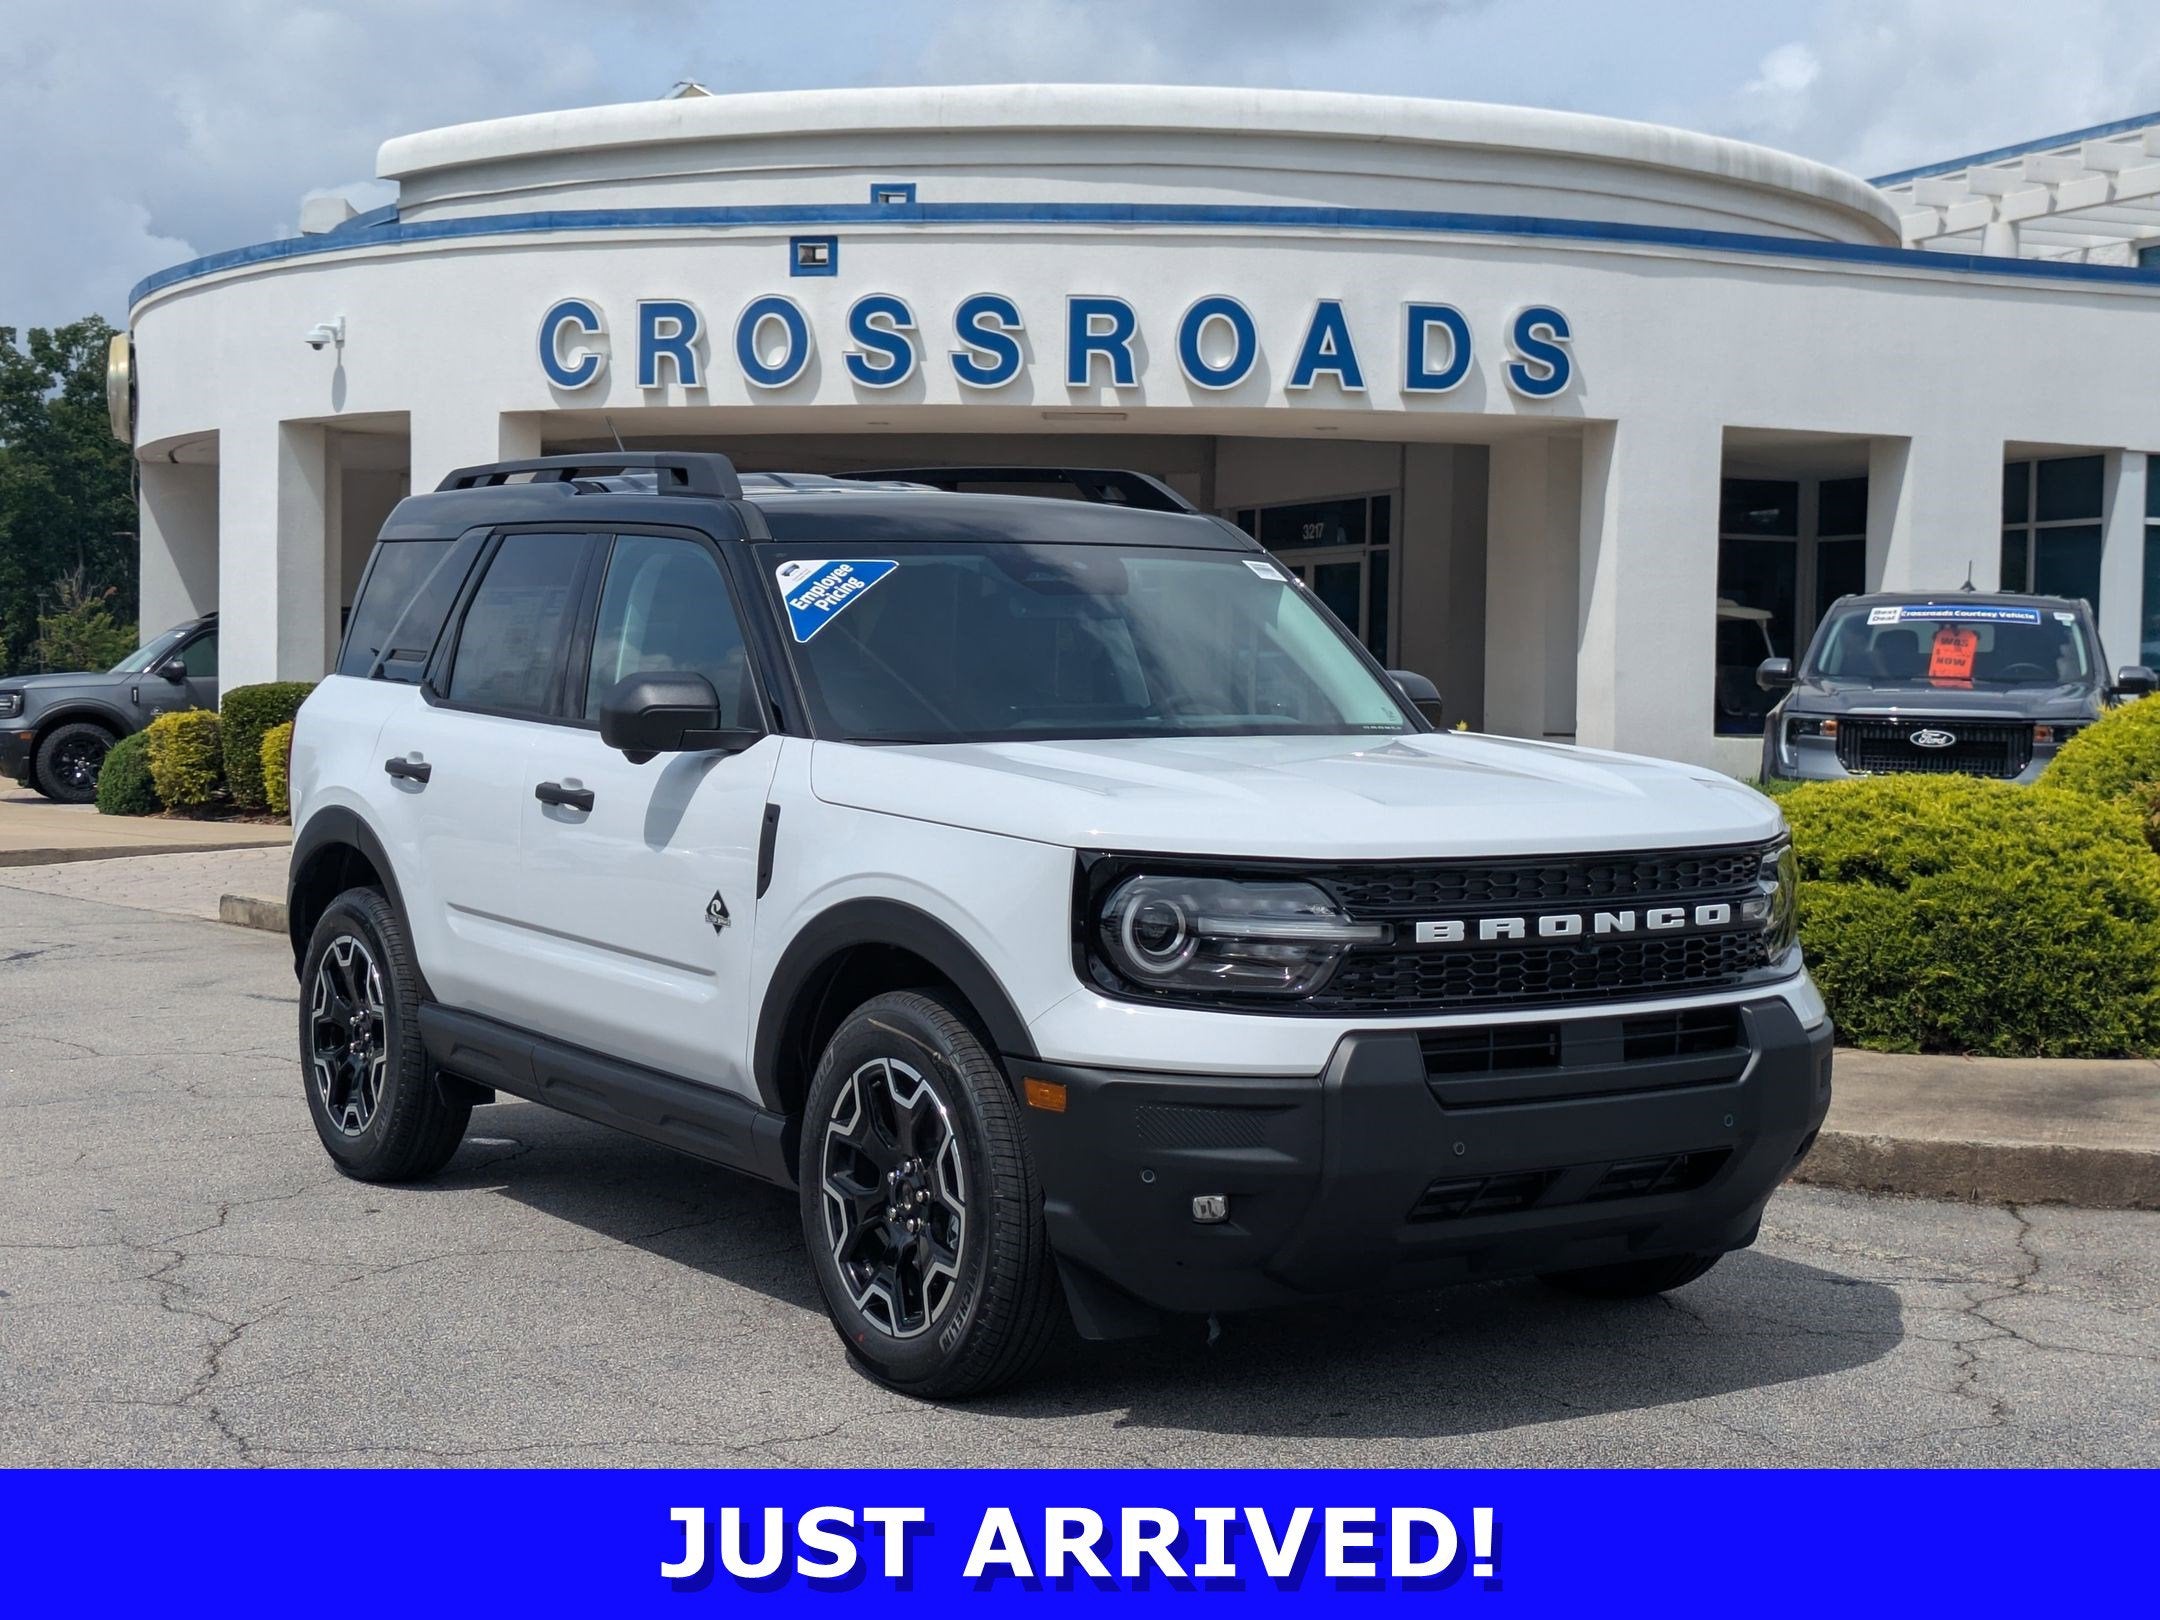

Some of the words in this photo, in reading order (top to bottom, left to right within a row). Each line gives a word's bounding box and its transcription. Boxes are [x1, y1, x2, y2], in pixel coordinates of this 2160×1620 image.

[537, 293, 1573, 399] CROSSROADS
[1302, 523, 1325, 540] 3217
[789, 563, 854, 610] Employee
[814, 576, 865, 612] Pricing
[1954, 610, 1997, 618] Courtesy
[1999, 611, 2035, 619] Vehicle
[1416, 904, 1731, 943] BRONCO
